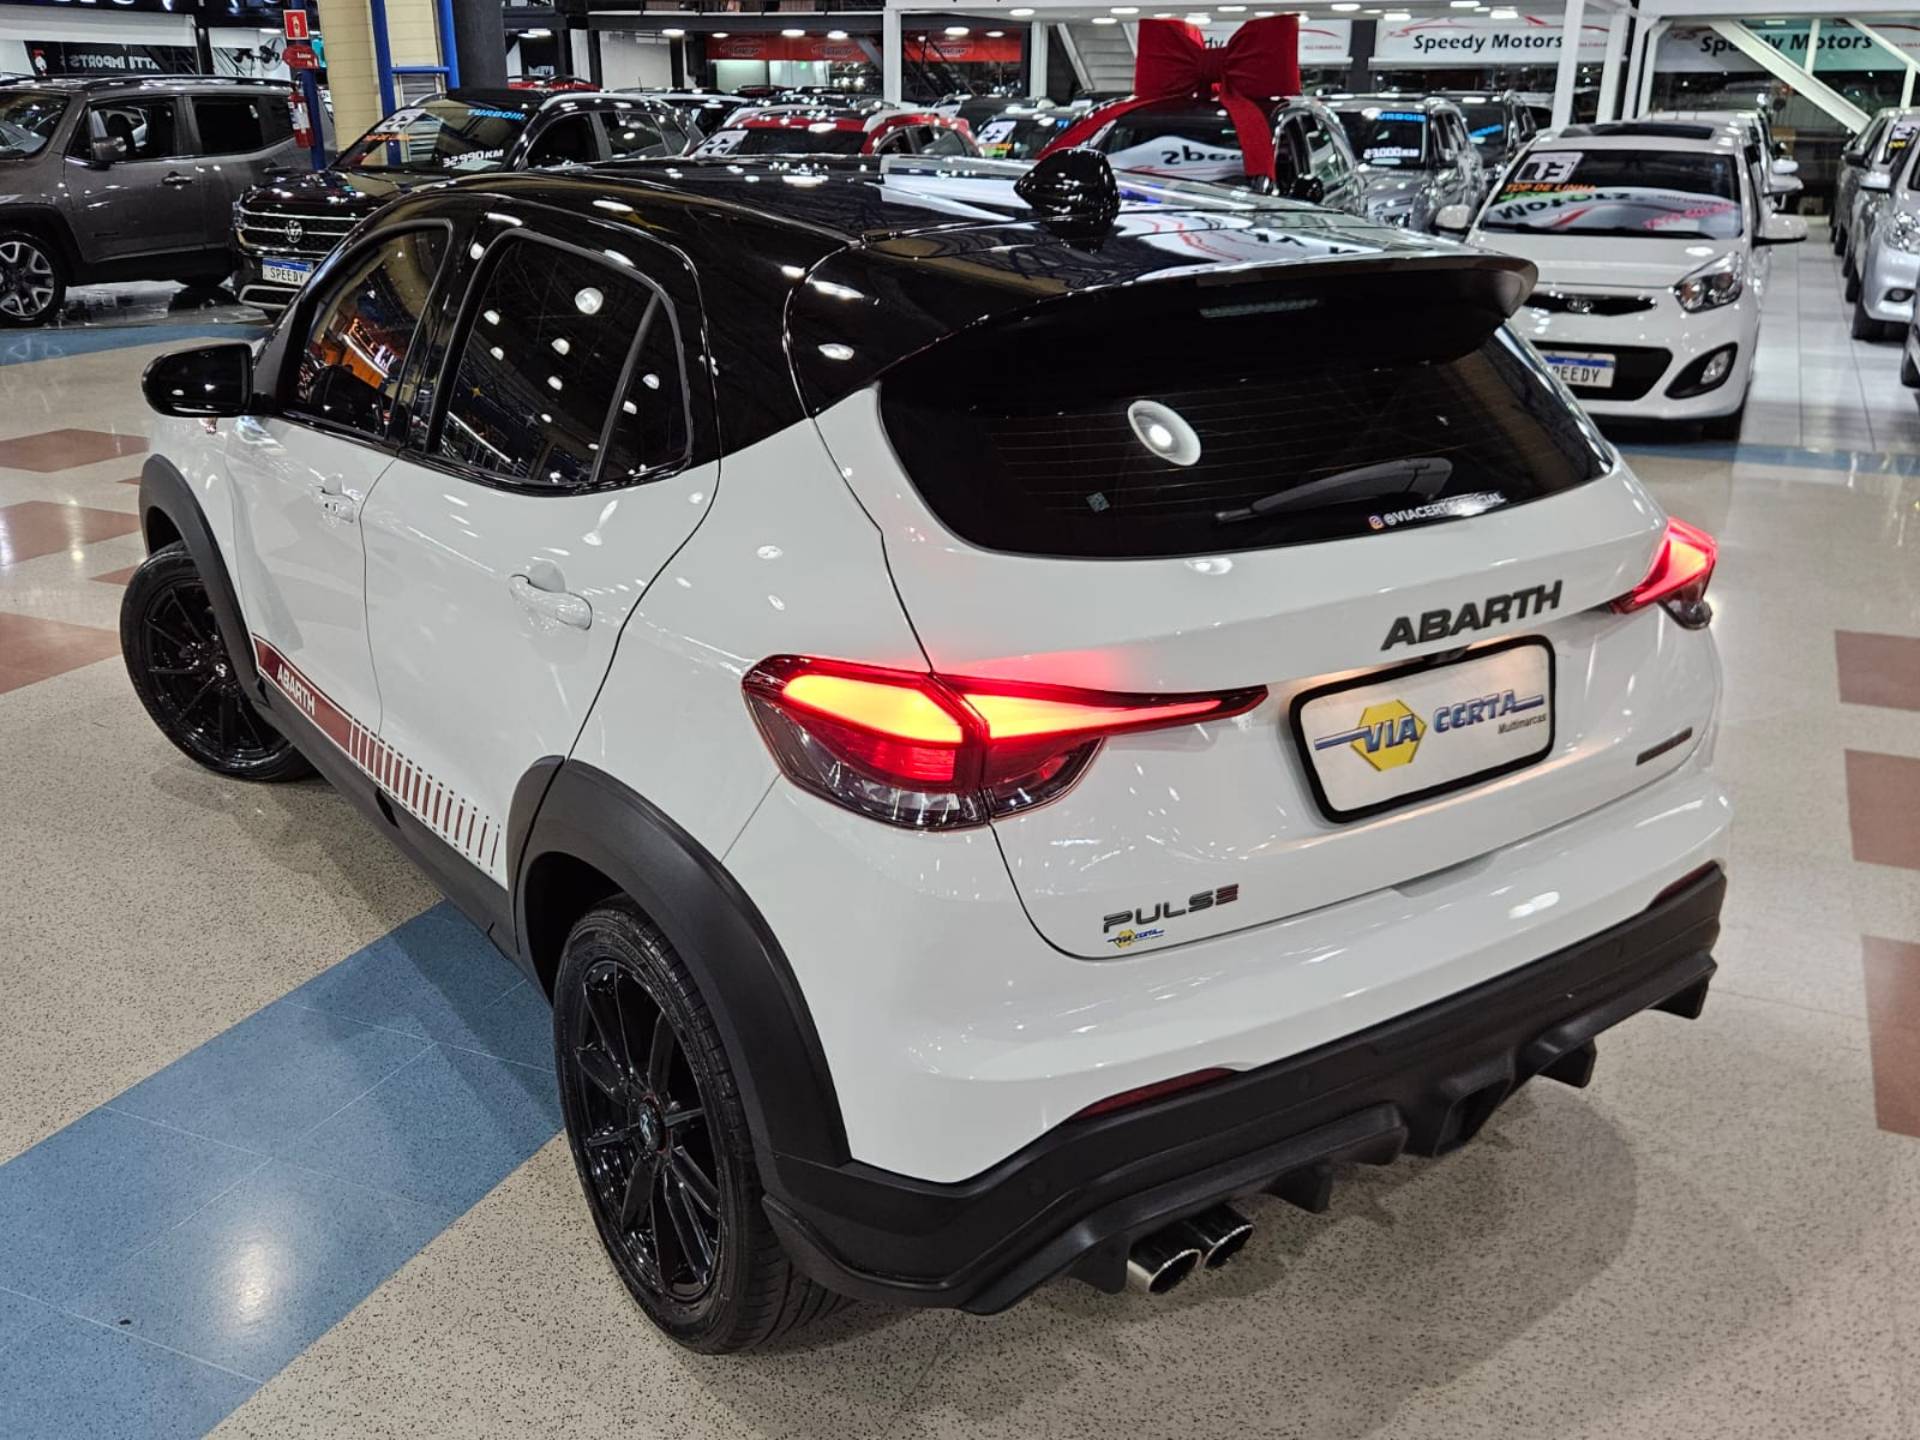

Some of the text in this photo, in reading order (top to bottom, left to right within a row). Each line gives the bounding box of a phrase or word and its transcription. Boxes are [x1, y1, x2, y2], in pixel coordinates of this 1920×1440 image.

[1413, 34, 1486, 53] Speedy
[1491, 34, 1563, 49] Motors
[485, 149, 504, 159] KM
[269, 267, 305, 284] SPEEDY
[1380, 579, 1563, 651] ABARTH
[276, 663, 316, 717] ABARTH
[1361, 689, 1520, 754] VIA CERTA
